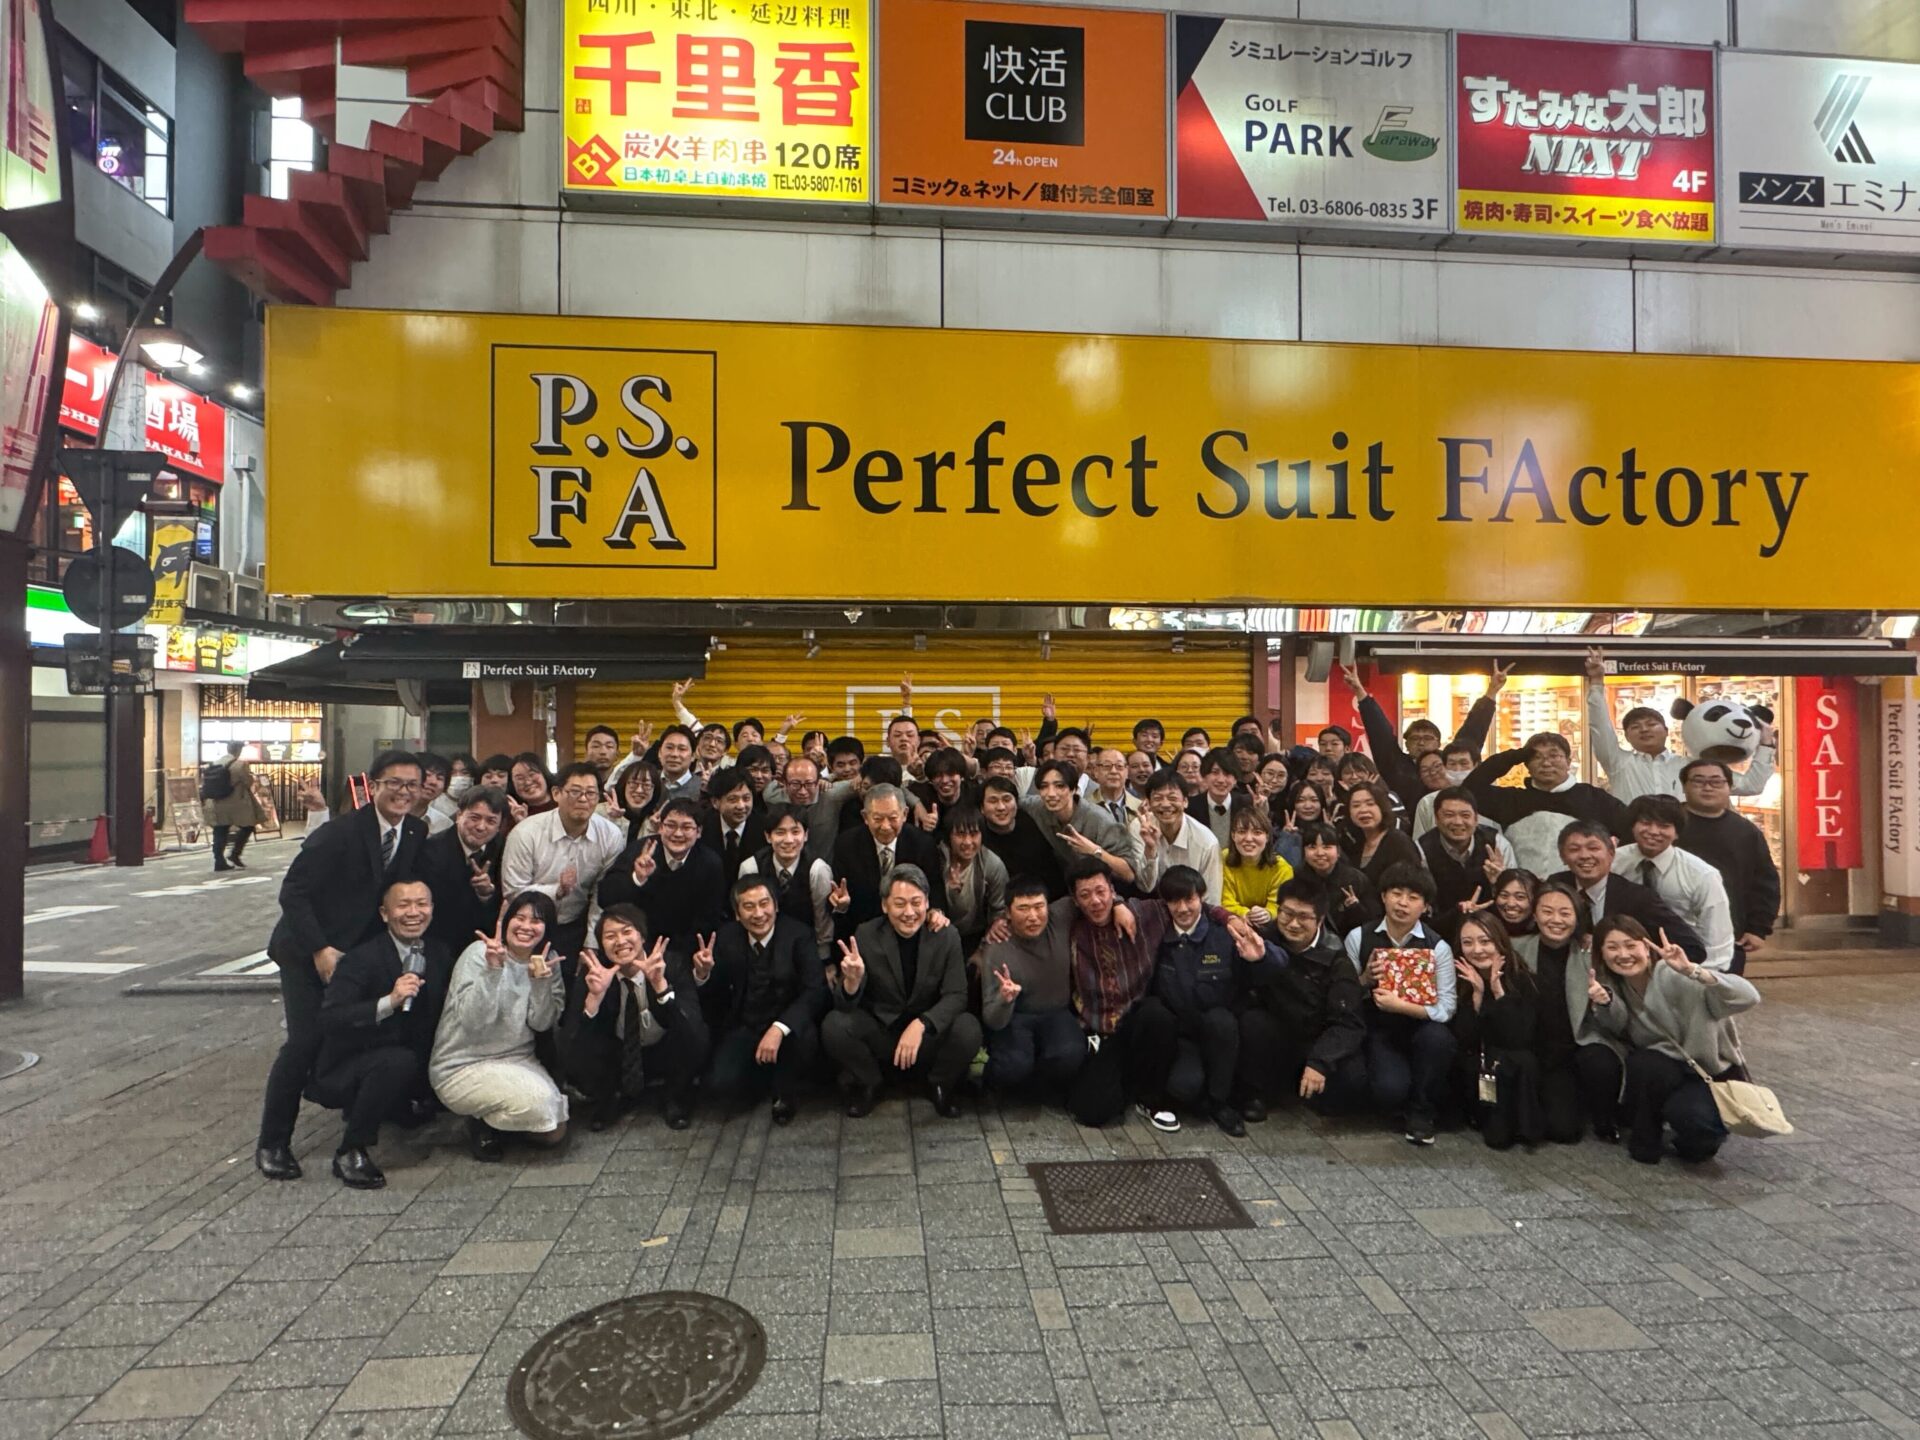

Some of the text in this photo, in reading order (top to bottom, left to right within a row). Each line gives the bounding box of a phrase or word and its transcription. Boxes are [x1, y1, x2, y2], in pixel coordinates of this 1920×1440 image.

[983, 44, 1067, 88] 快活
[1229, 40, 1413, 69] シミュレーションゴルフ
[574, 31, 860, 127] 千里香
[985, 92, 1067, 123] CLUB
[1245, 94, 1299, 113] GOLF
[1463, 76, 1706, 138] すたみな太郎
[624, 132, 767, 164] 炭火羊肉串
[775, 142, 861, 170] 120席
[1245, 120, 1354, 158] PARK
[1521, 133, 1653, 181] NEXT
[572, 142, 612, 180] B1
[1024, 156, 1058, 168] OPEN
[1672, 170, 1708, 193] 4F
[1748, 177, 1920, 213] メンズ エミナ
[1267, 197, 1439, 220] Tel. 03-6806-0835 3F
[1464, 200, 1709, 232] 焼肉・寿司・スイーツ食べ放題
[529, 373, 698, 459] P.S.
[781, 420, 1808, 558] Perfect Suit FActory
[529, 465, 686, 550] FA
[483, 664, 597, 678] Perfect Suit FActory
[1620, 662, 1649, 671] Perfect
[1652, 662, 1669, 671] Suit
[1672, 662, 1706, 673] FActory
[1811, 695, 1844, 837] SALE
[1885, 703, 1904, 855] Perfect Suit FActory
